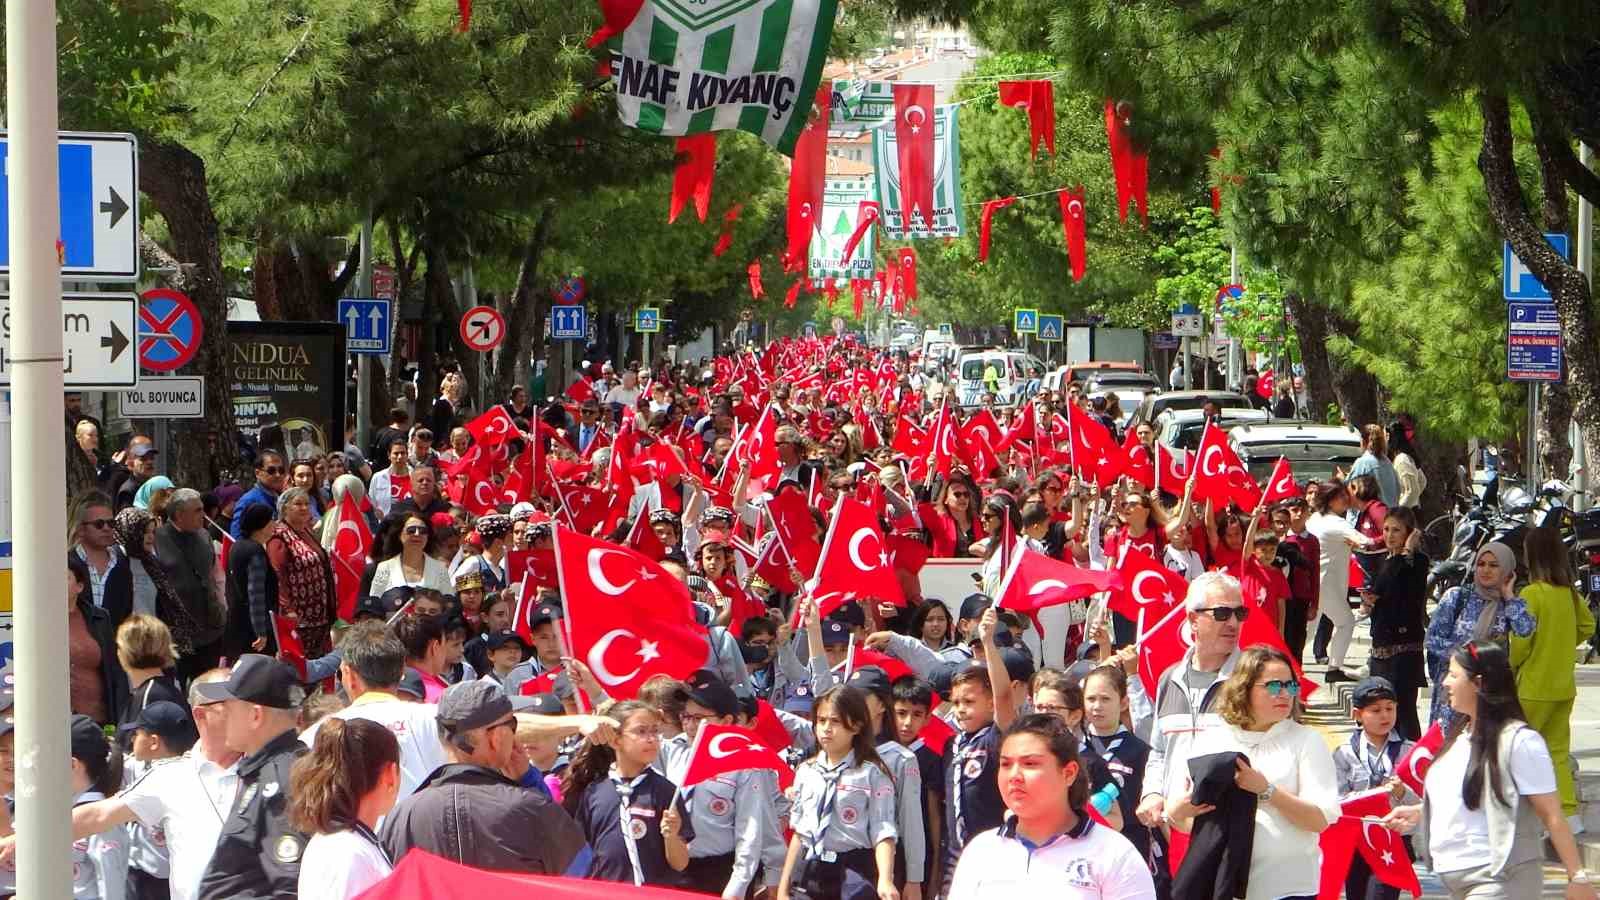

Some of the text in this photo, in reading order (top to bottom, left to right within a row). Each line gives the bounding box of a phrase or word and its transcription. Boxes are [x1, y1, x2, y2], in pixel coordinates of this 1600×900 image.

[687, 73, 795, 120] KIYANÇ
[1516, 309, 1525, 320] P
[126, 391, 197, 404] YOL BOYUNCA
